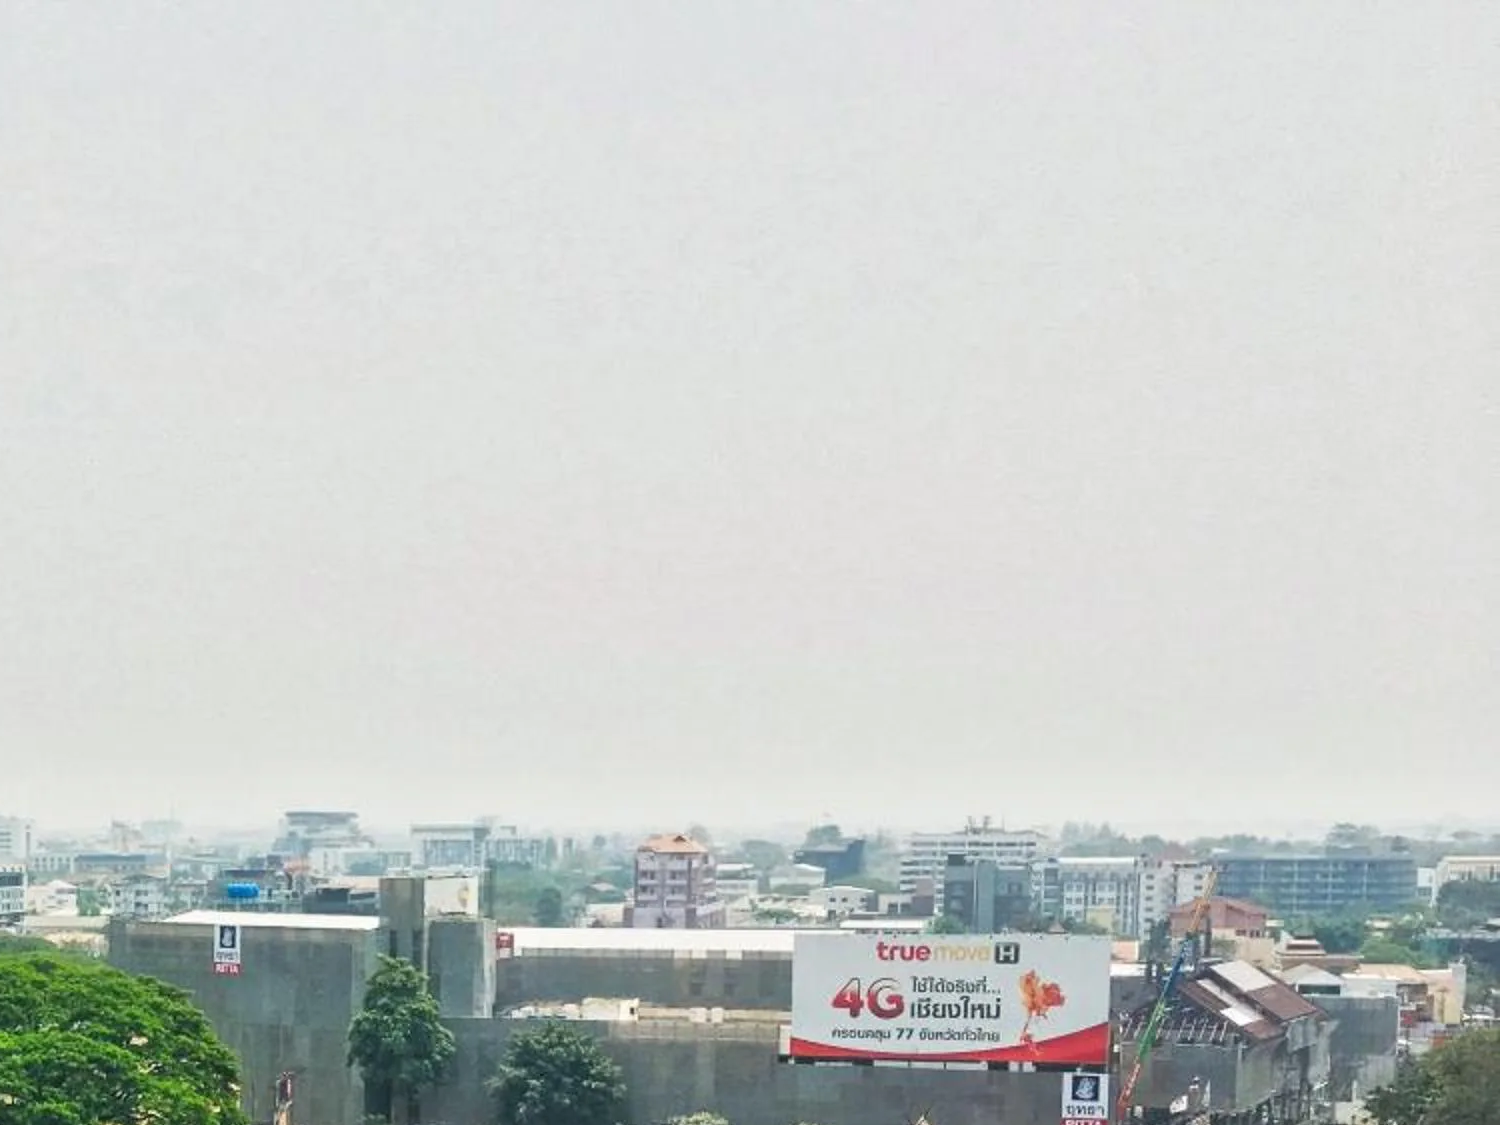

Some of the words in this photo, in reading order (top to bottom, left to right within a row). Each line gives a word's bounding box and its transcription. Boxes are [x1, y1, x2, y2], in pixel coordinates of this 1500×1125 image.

[831, 977, 905, 1019] 4G
[910, 995, 1001, 1019] เชียงใหม่
[896, 1028, 915, 1040] 77
